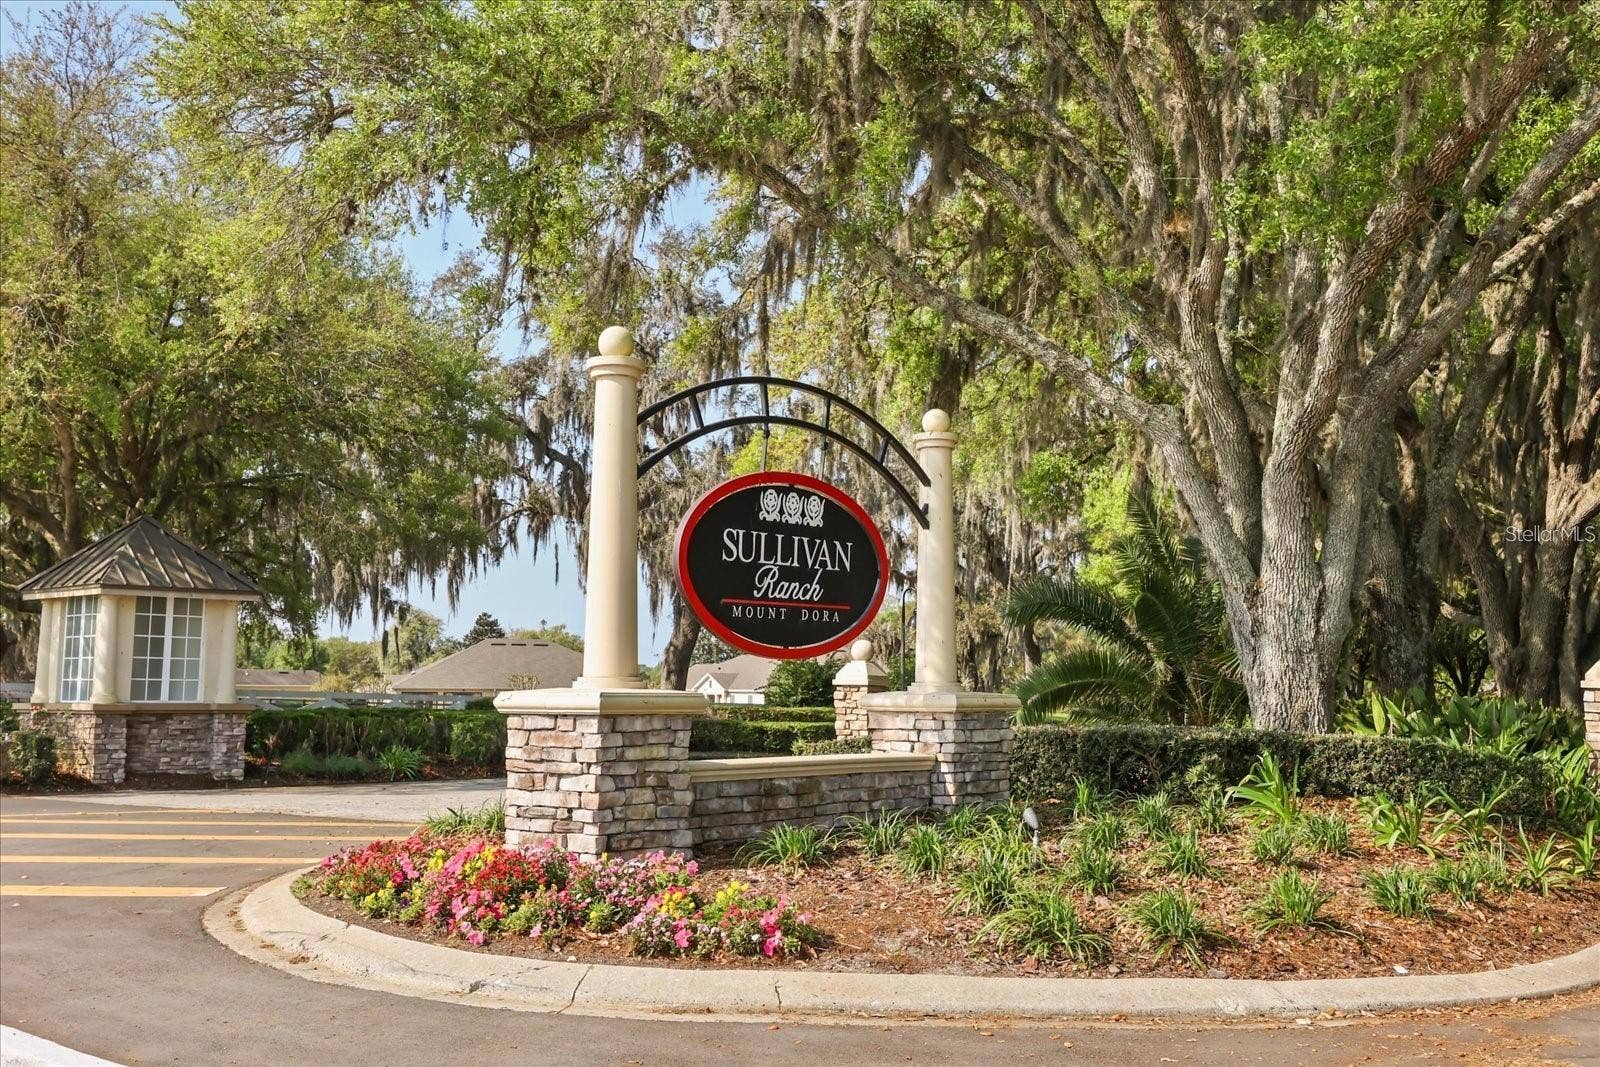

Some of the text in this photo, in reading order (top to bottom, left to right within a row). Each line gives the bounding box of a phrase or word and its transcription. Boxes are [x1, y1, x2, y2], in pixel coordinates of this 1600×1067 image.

[722, 528, 853, 572] SULLIVAN
[753, 565, 824, 601] Ranch
[732, 605, 840, 623] MOUNT DORA
